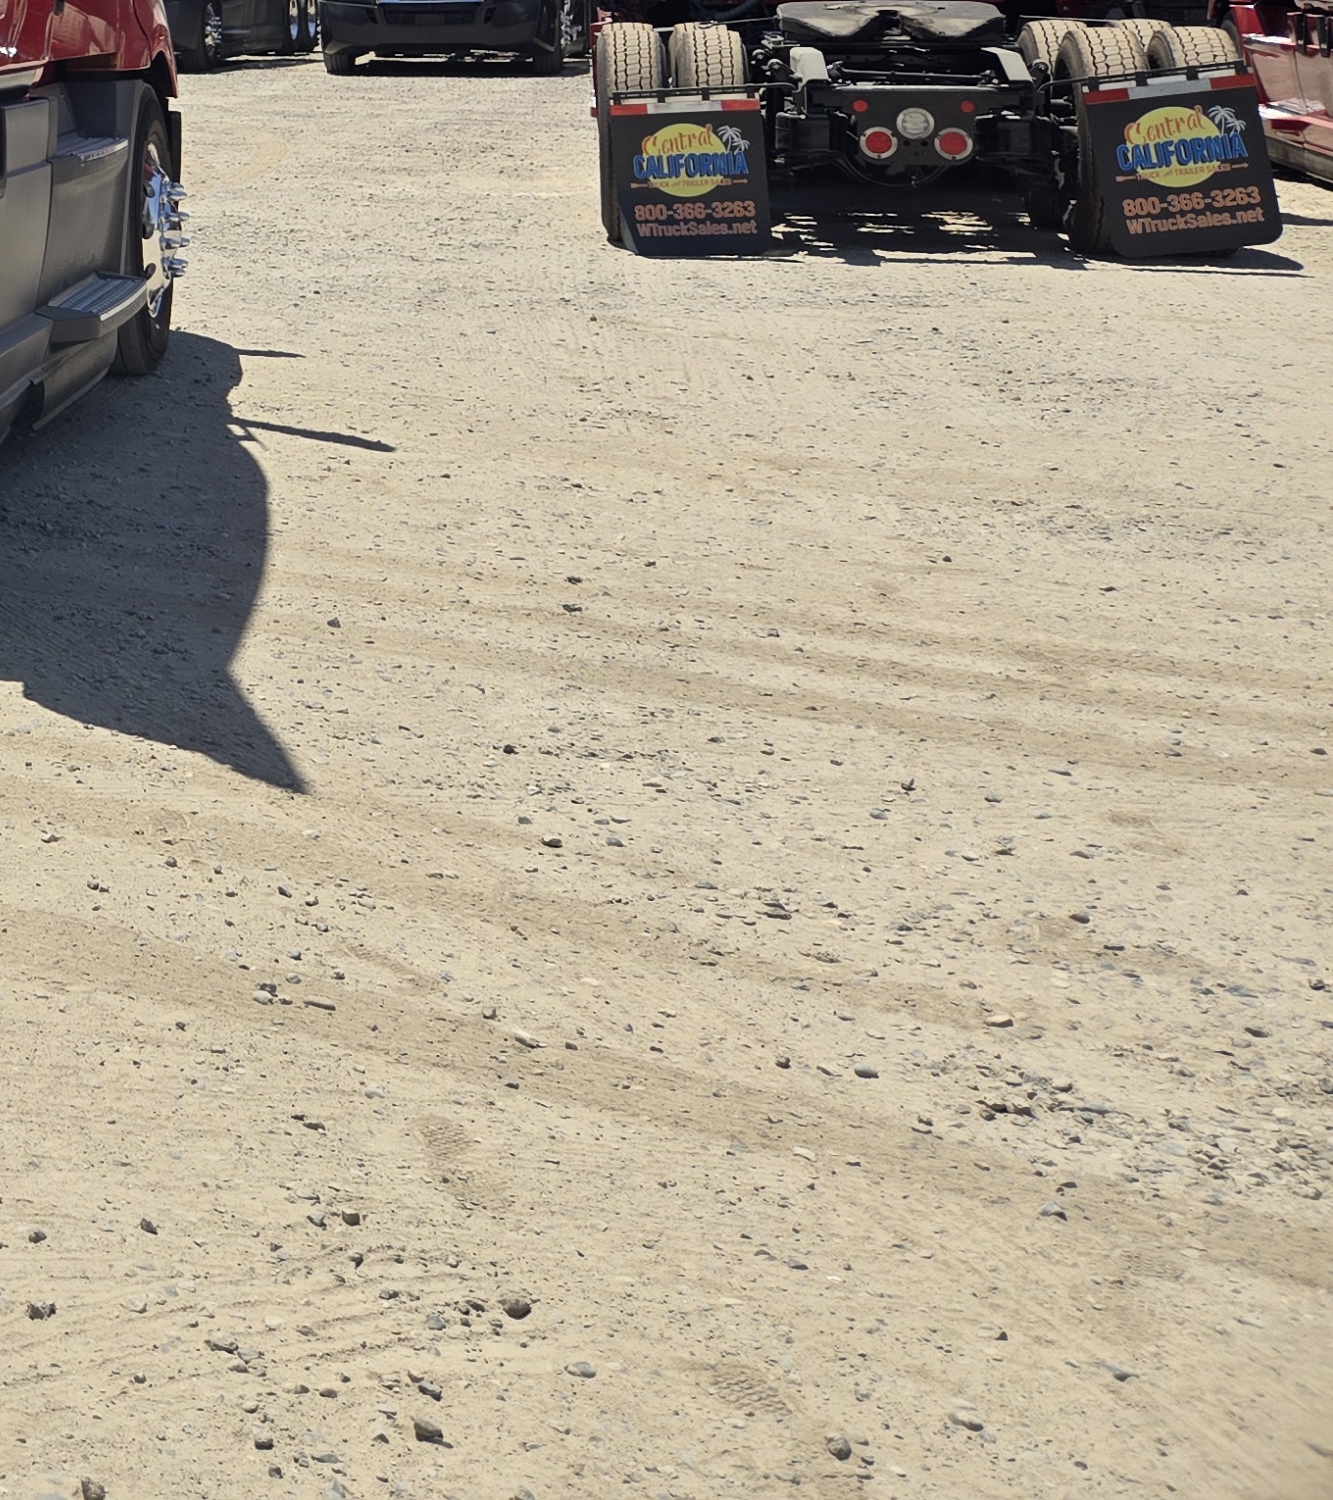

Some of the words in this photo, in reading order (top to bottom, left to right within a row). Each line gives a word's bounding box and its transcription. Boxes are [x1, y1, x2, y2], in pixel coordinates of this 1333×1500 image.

[641, 123, 714, 156] Central
[1124, 104, 1206, 145] Central
[633, 150, 749, 179] CALIFORNIA
[1116, 132, 1248, 171] CALIFORNIA
[634, 200, 756, 221] 800-366-3263
[1122, 186, 1261, 217] 800-366-3263
[636, 219, 758, 237] WTruckSales.net
[1125, 206, 1265, 235] WTruckSales.net
